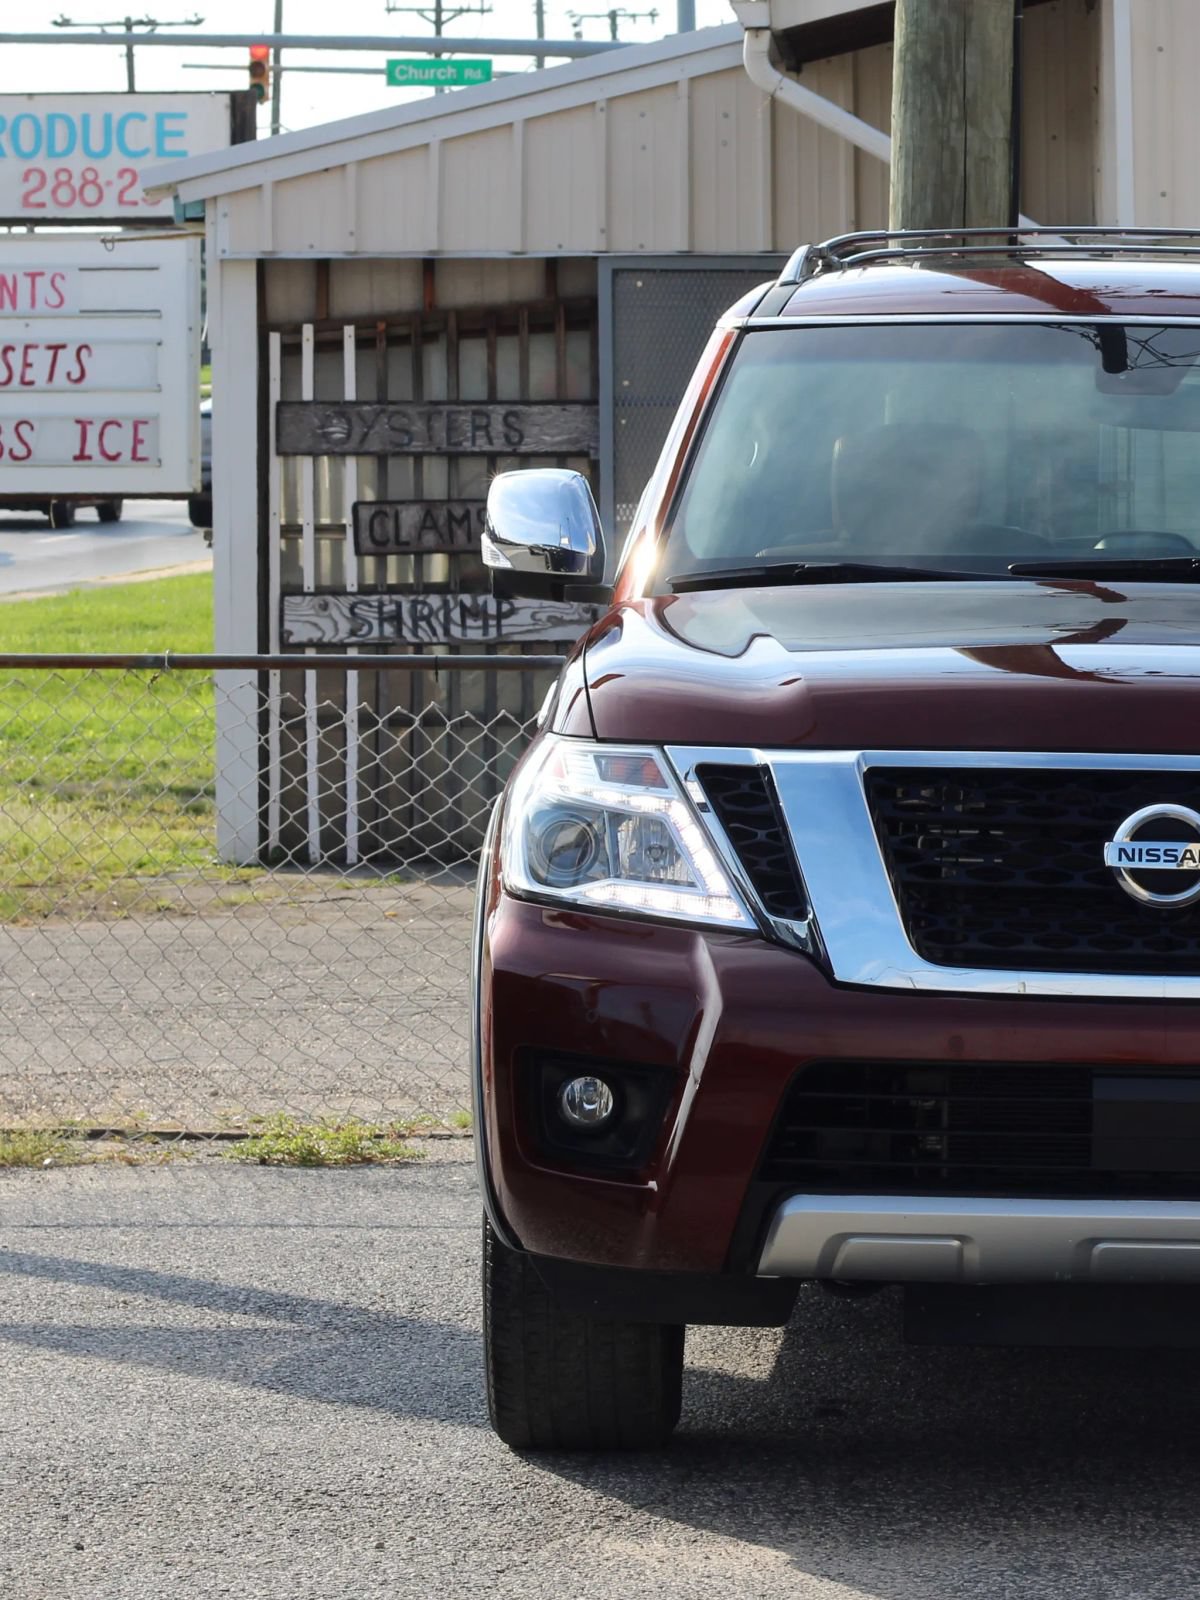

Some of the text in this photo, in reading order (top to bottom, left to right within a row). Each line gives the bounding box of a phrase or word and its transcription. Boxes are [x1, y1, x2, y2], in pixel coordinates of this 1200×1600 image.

[395, 65, 457, 80] Church
[0, 112, 188, 159] ODUCE
[22, 167, 162, 209] 288-2
[0, 344, 92, 386] SETS
[72, 419, 149, 462] ICE
[318, 408, 525, 448] OYSTERS
[348, 598, 516, 639] SHRIMP
